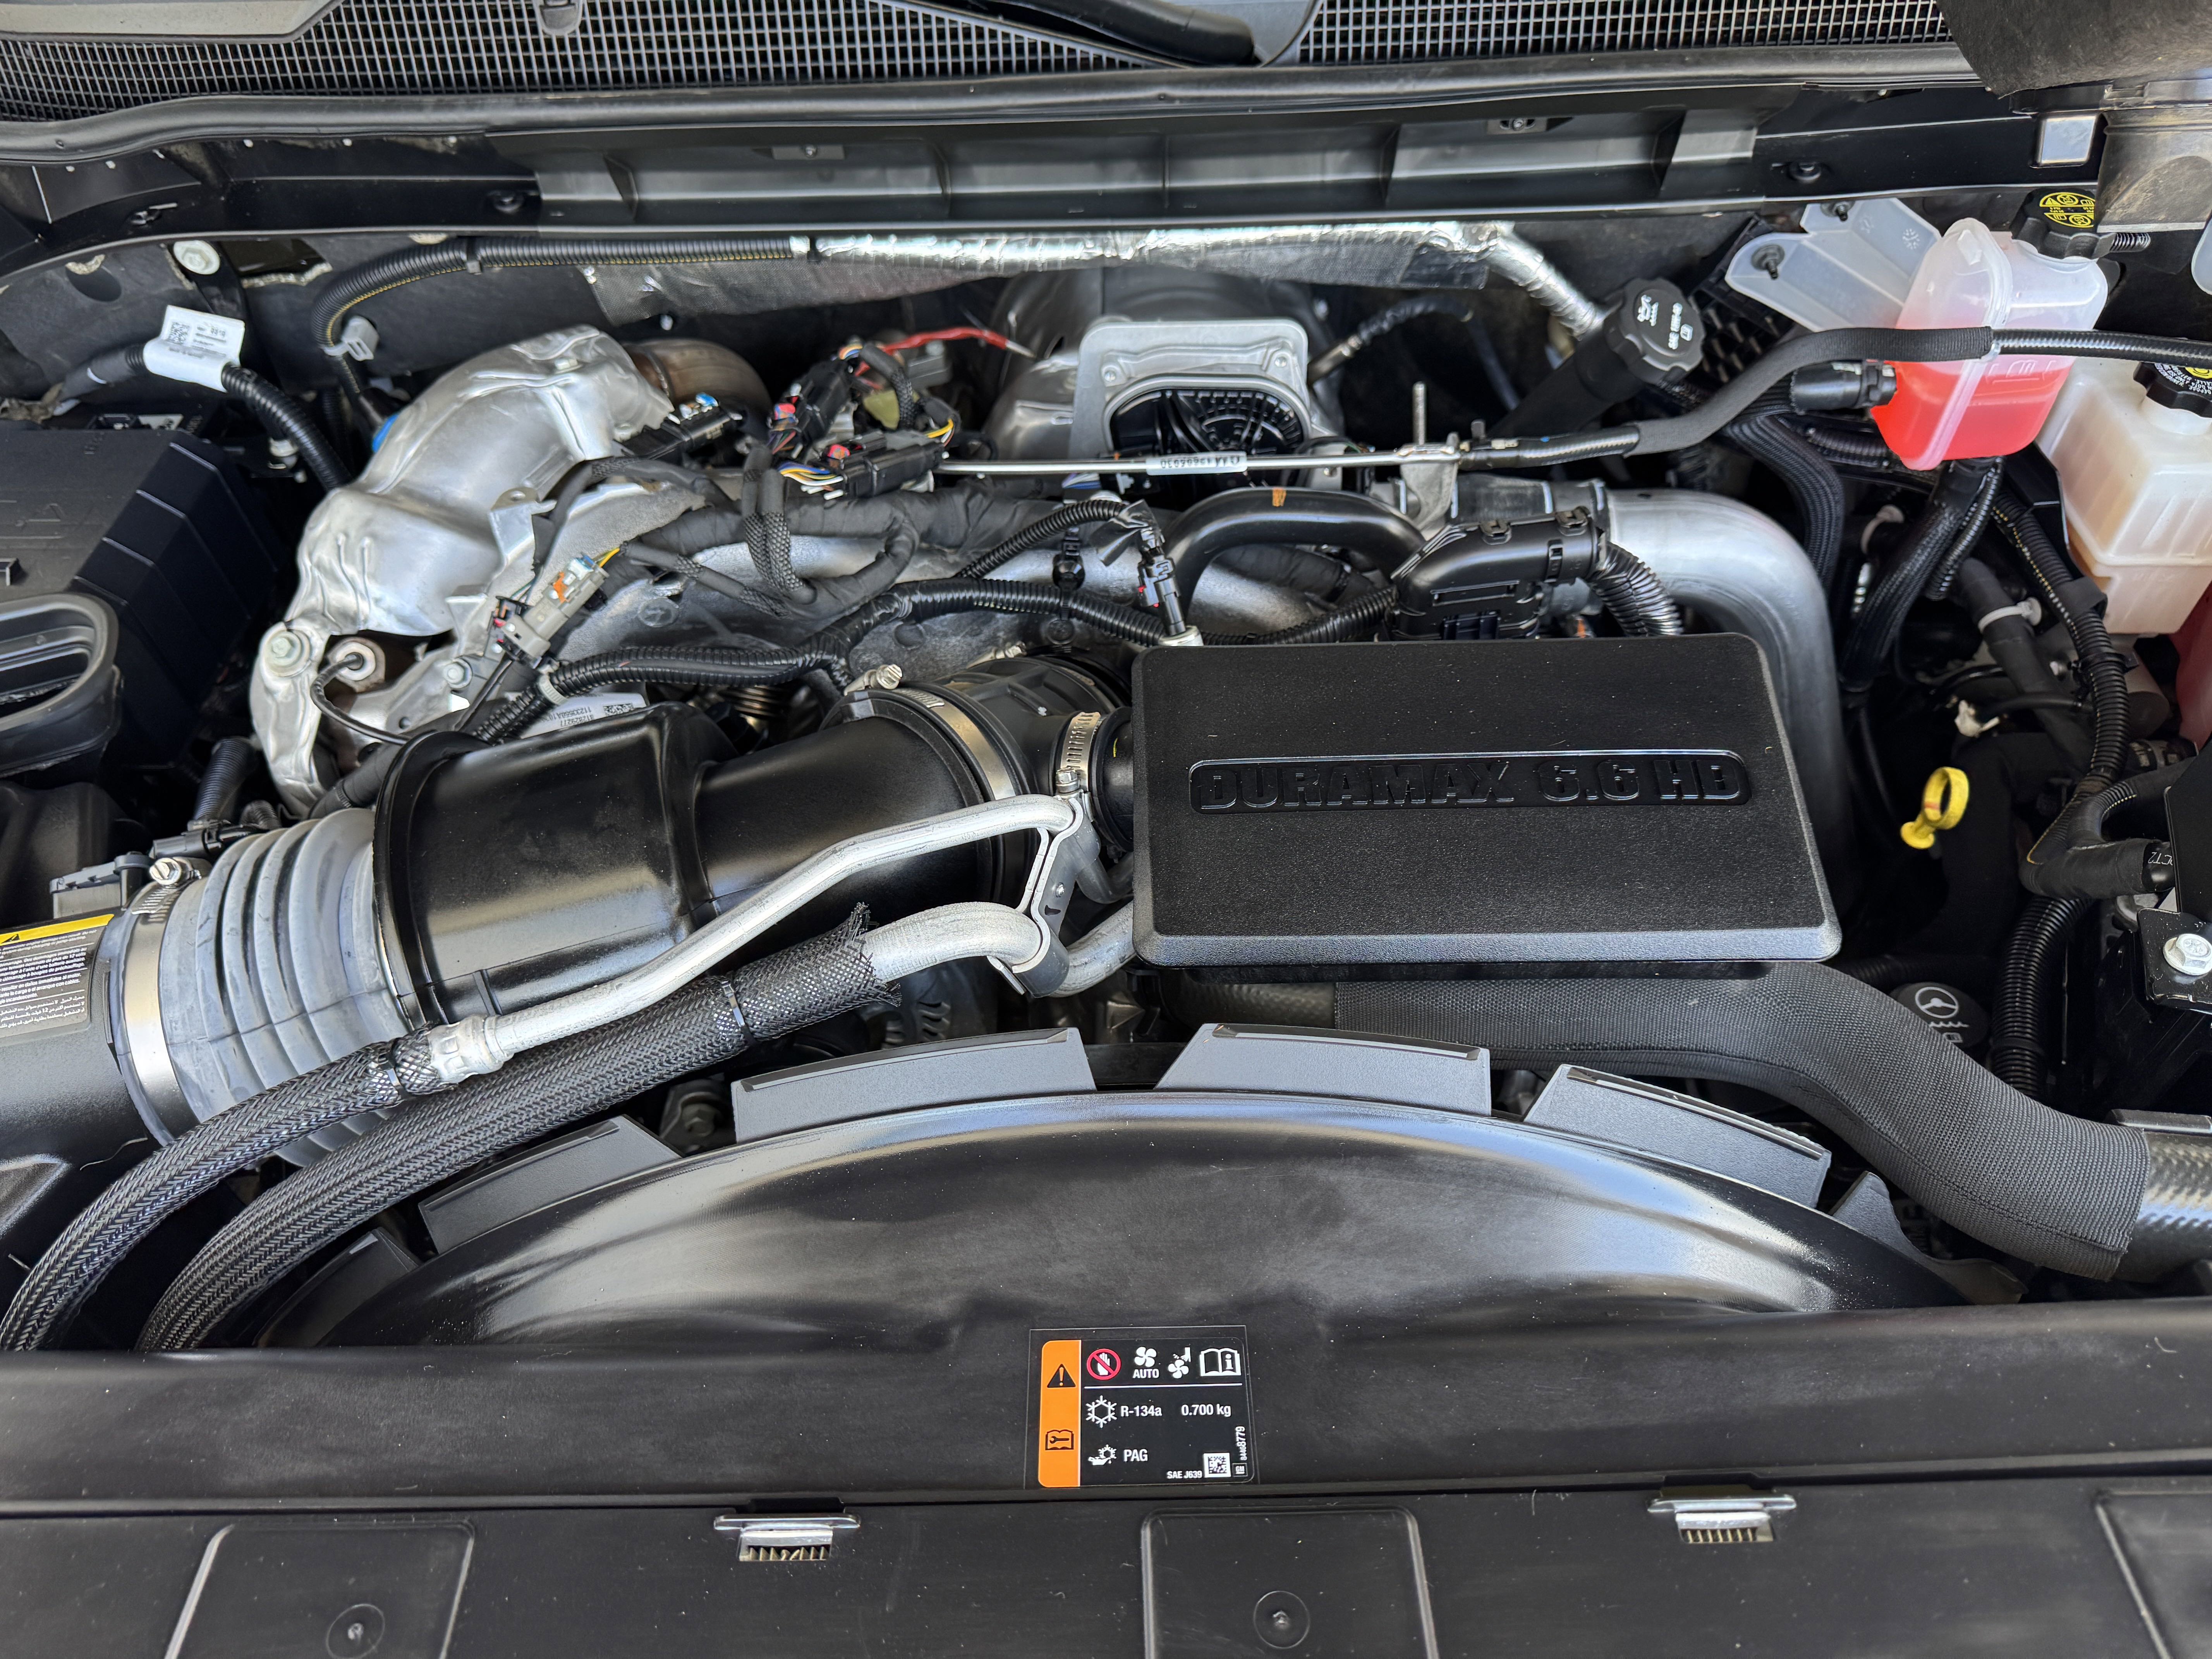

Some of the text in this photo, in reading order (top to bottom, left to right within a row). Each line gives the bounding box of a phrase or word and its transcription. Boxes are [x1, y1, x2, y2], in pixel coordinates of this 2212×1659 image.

[1199, 759, 1741, 809] DURAMAX 6.6 HD
[1133, 1369, 1159, 1379] AUTO
[1120, 1404, 1231, 1417] R-134a 0.700 kg
[1124, 1449, 1148, 1462] PAG
[1167, 1470, 1202, 1479] SAE J639
[1235, 1466, 1245, 1474] GM
